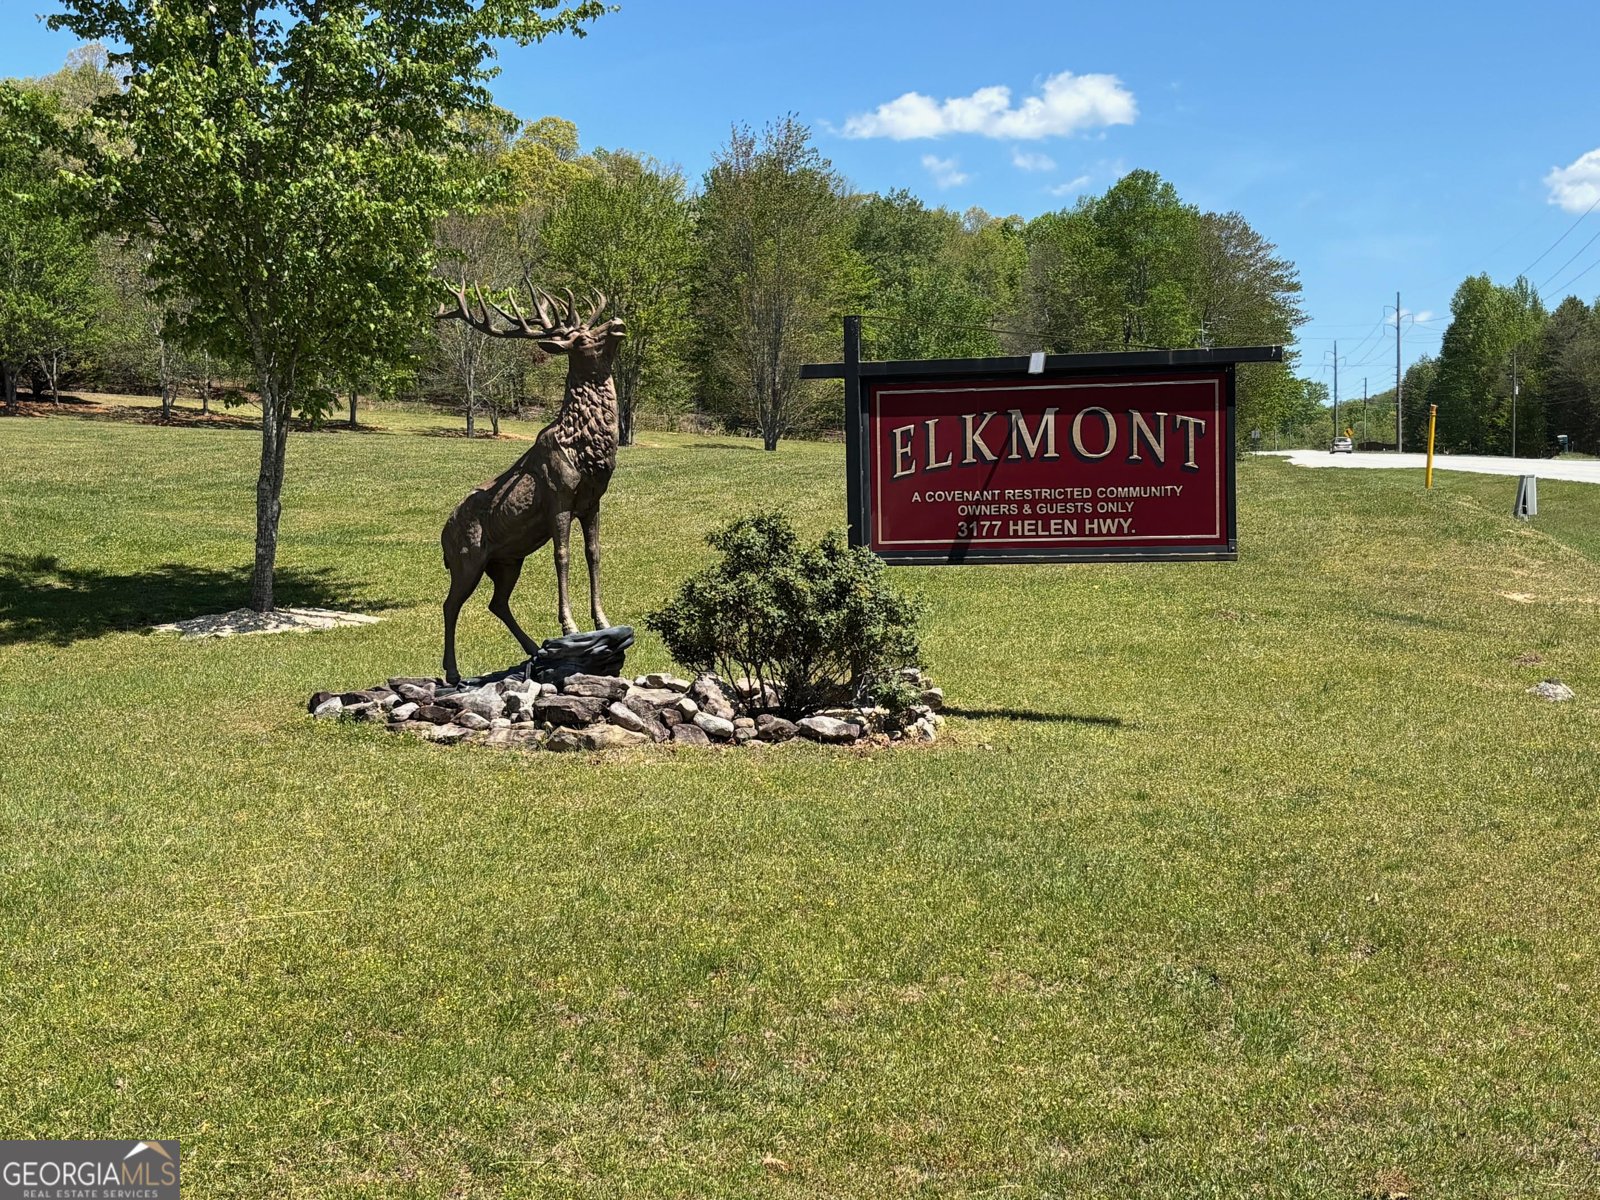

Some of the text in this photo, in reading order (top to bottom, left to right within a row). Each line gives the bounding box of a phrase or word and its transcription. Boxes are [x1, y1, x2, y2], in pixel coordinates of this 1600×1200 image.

[892, 406, 1206, 479] ELKMONT
[912, 485, 1183, 503] A COVENANT RESTRICTED COMMUNITY
[958, 501, 1135, 516] OWNERS & GUESTS ONLY
[957, 518, 1136, 537] 3177 HELEN HWY.
